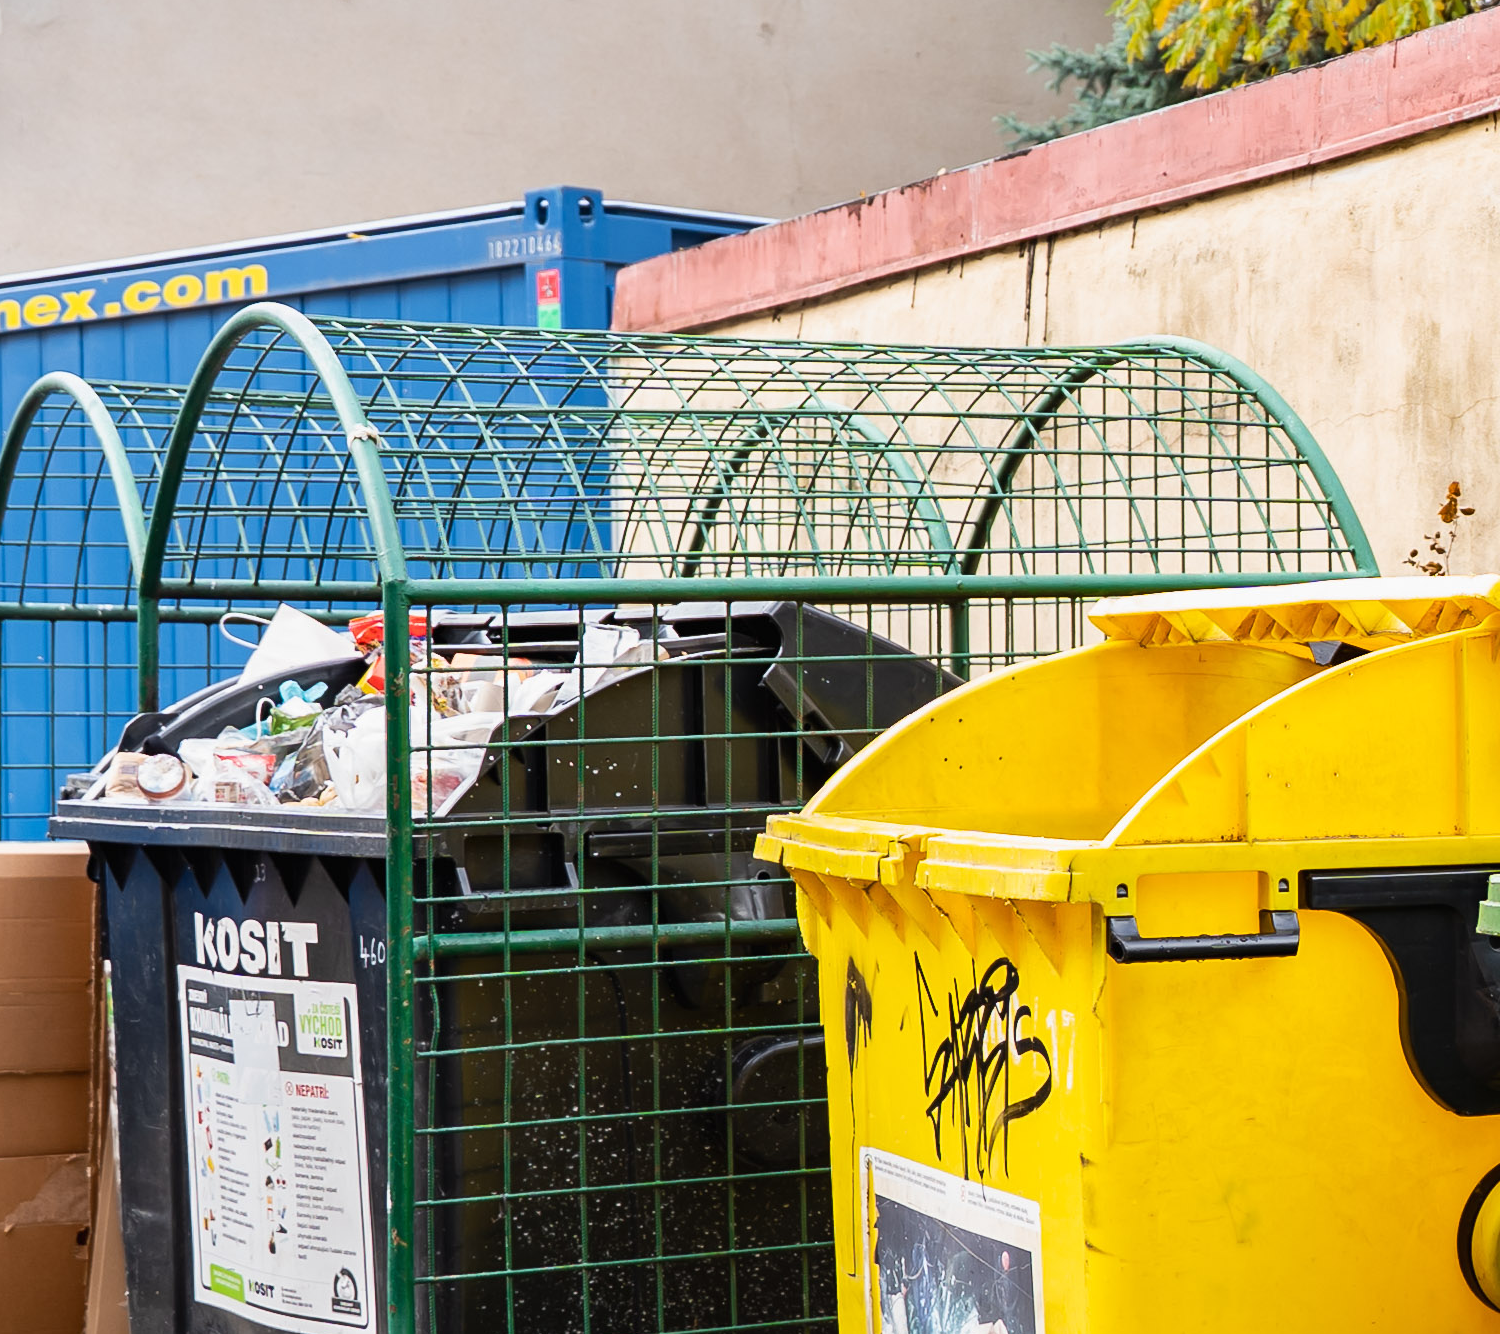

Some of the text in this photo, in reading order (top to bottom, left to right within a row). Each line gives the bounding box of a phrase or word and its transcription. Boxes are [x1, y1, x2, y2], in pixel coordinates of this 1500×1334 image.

[194, 911, 319, 977] KOSIT
[359, 935, 385, 969] 460
[300, 1009, 342, 1036] VÝCHOD
[314, 1037, 342, 1050] KOSIT
[249, 1279, 275, 1299] KOSIT
